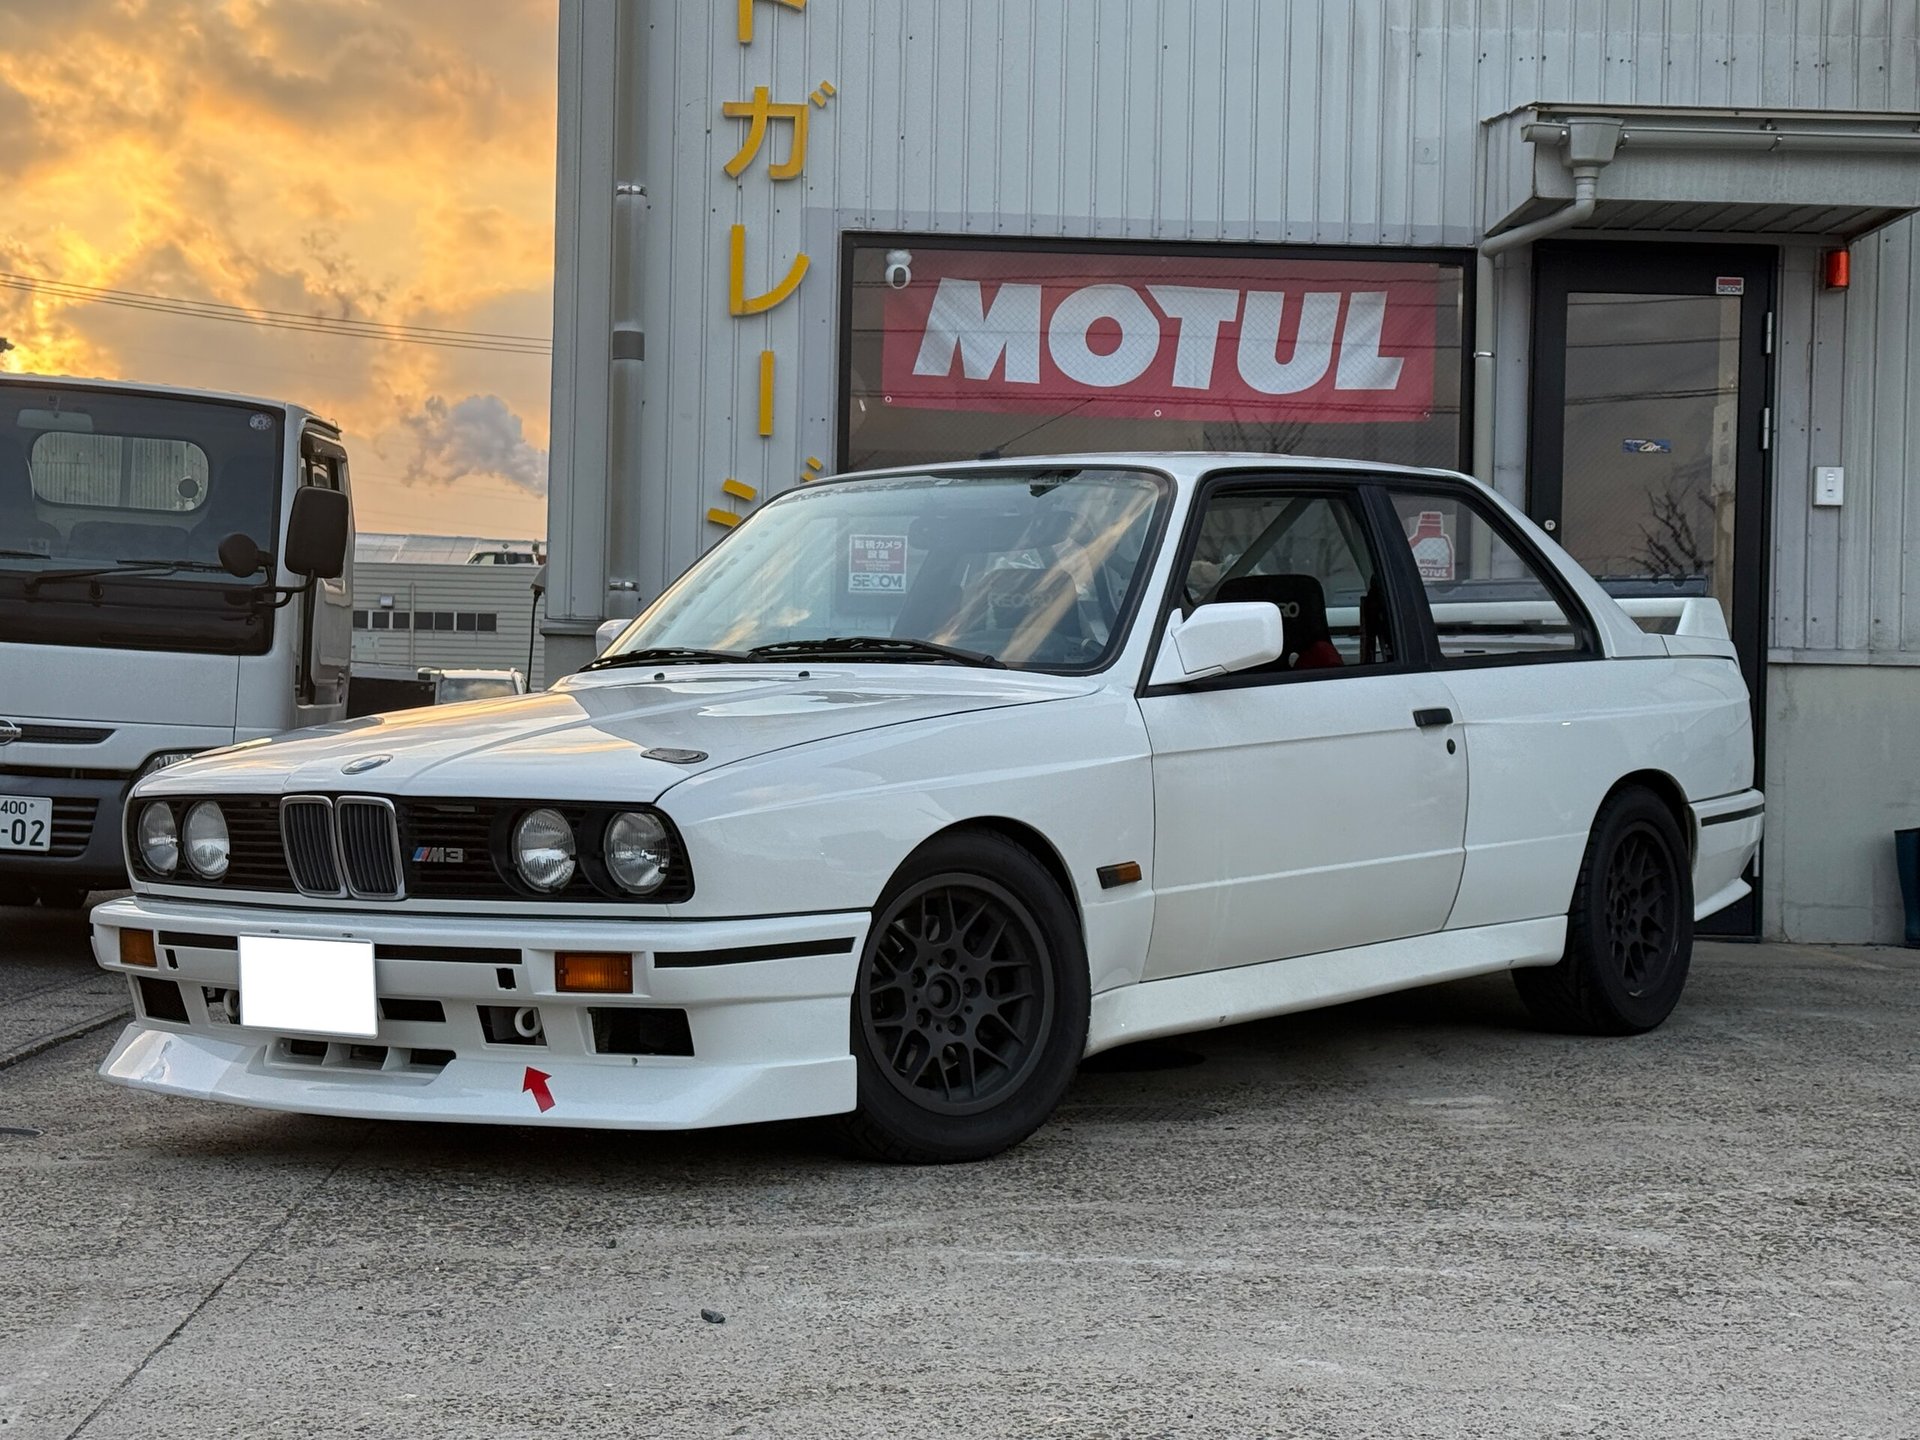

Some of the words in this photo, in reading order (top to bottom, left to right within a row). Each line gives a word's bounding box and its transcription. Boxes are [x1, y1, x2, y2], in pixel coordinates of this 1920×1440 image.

[912, 277, 1405, 394] MOTUL
[1419, 568, 1447, 576] OTUL
[852, 574, 902, 588] SECOM
[0, 801, 27, 815] 400
[427, 847, 463, 862] M3
